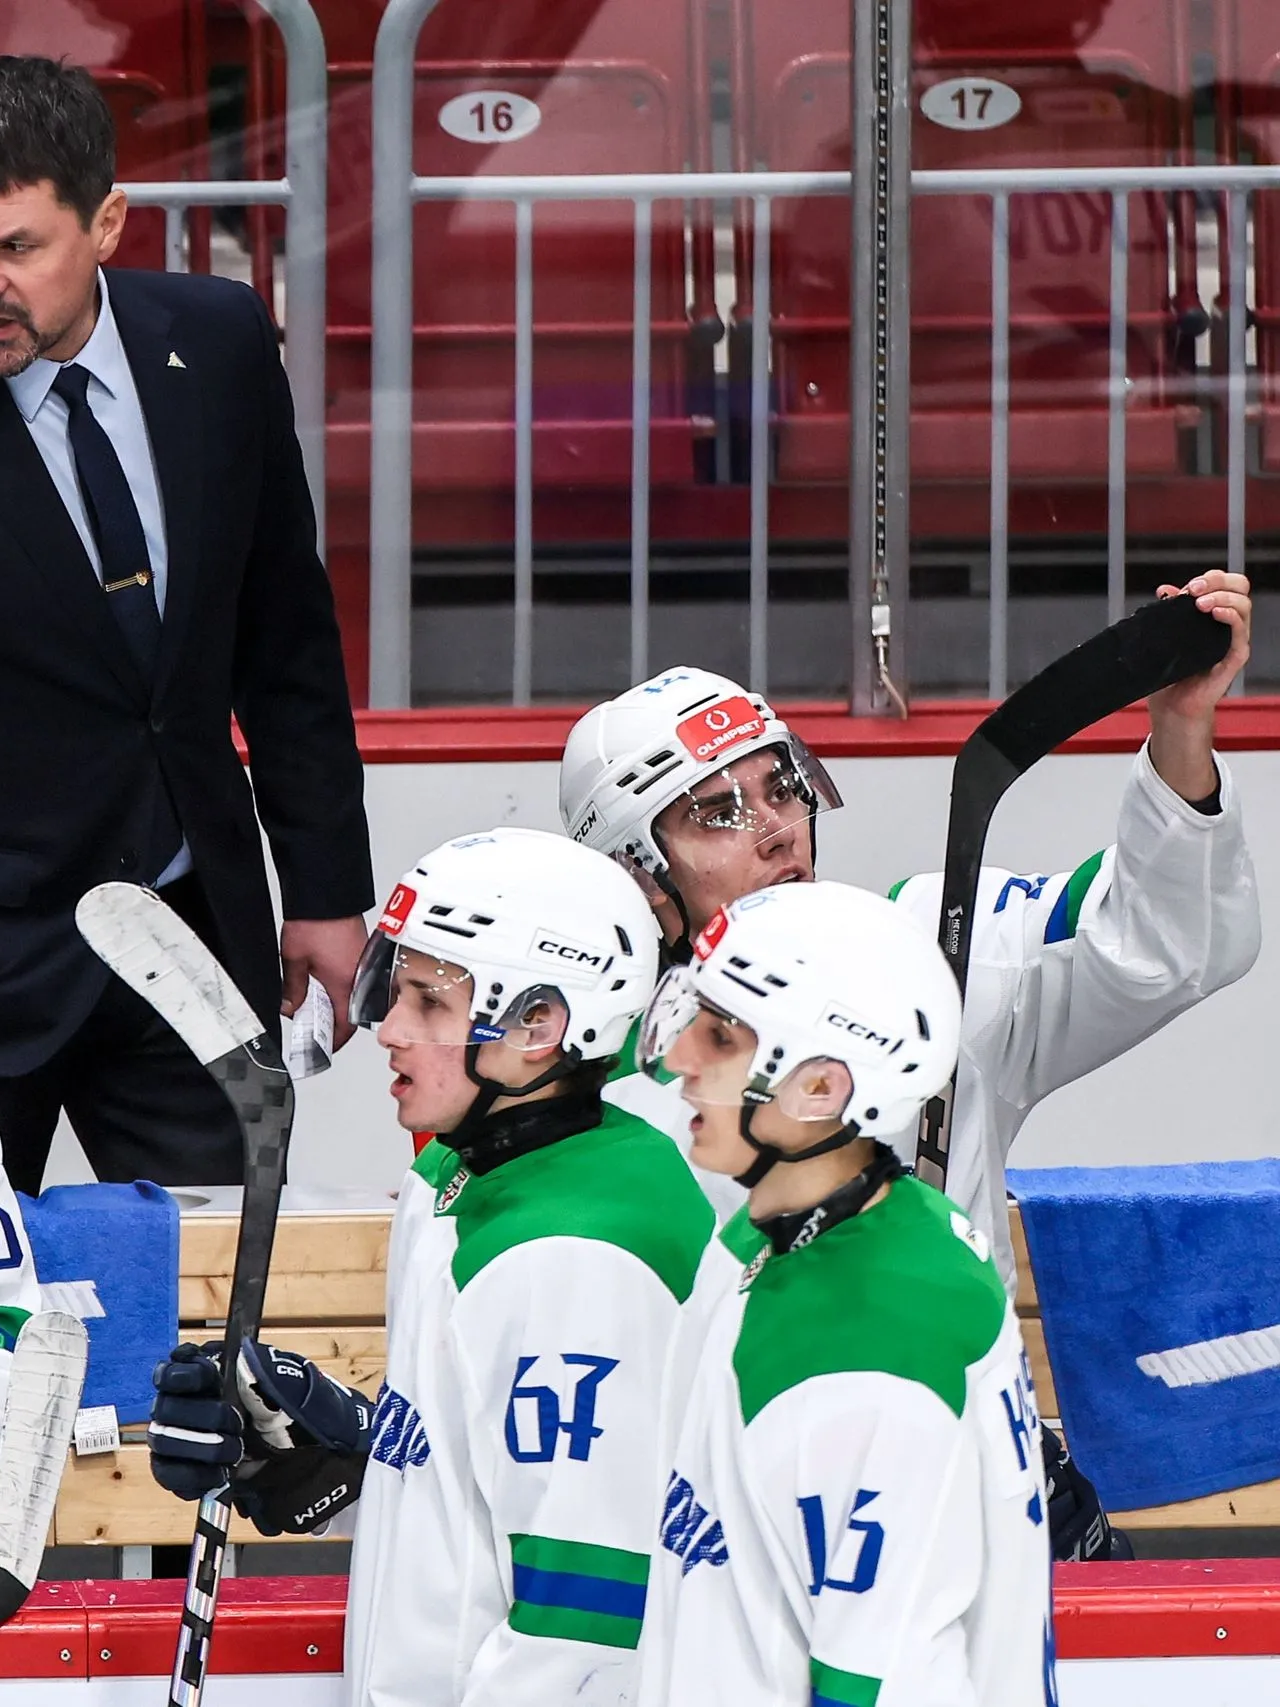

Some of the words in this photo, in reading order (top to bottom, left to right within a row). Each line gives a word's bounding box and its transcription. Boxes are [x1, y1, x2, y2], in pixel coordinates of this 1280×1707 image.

[468, 100, 514, 134] 16
[949, 88, 994, 121] 17
[696, 719, 761, 757] OLIMPBET
[573, 810, 597, 843] CCM
[537, 939, 602, 967] CCM
[473, 1027, 503, 1039] CCM
[827, 1012, 889, 1048] CCM
[276, 1364, 304, 1379] CCM
[504, 1353, 621, 1463] 67
[293, 1483, 349, 1527] CCM
